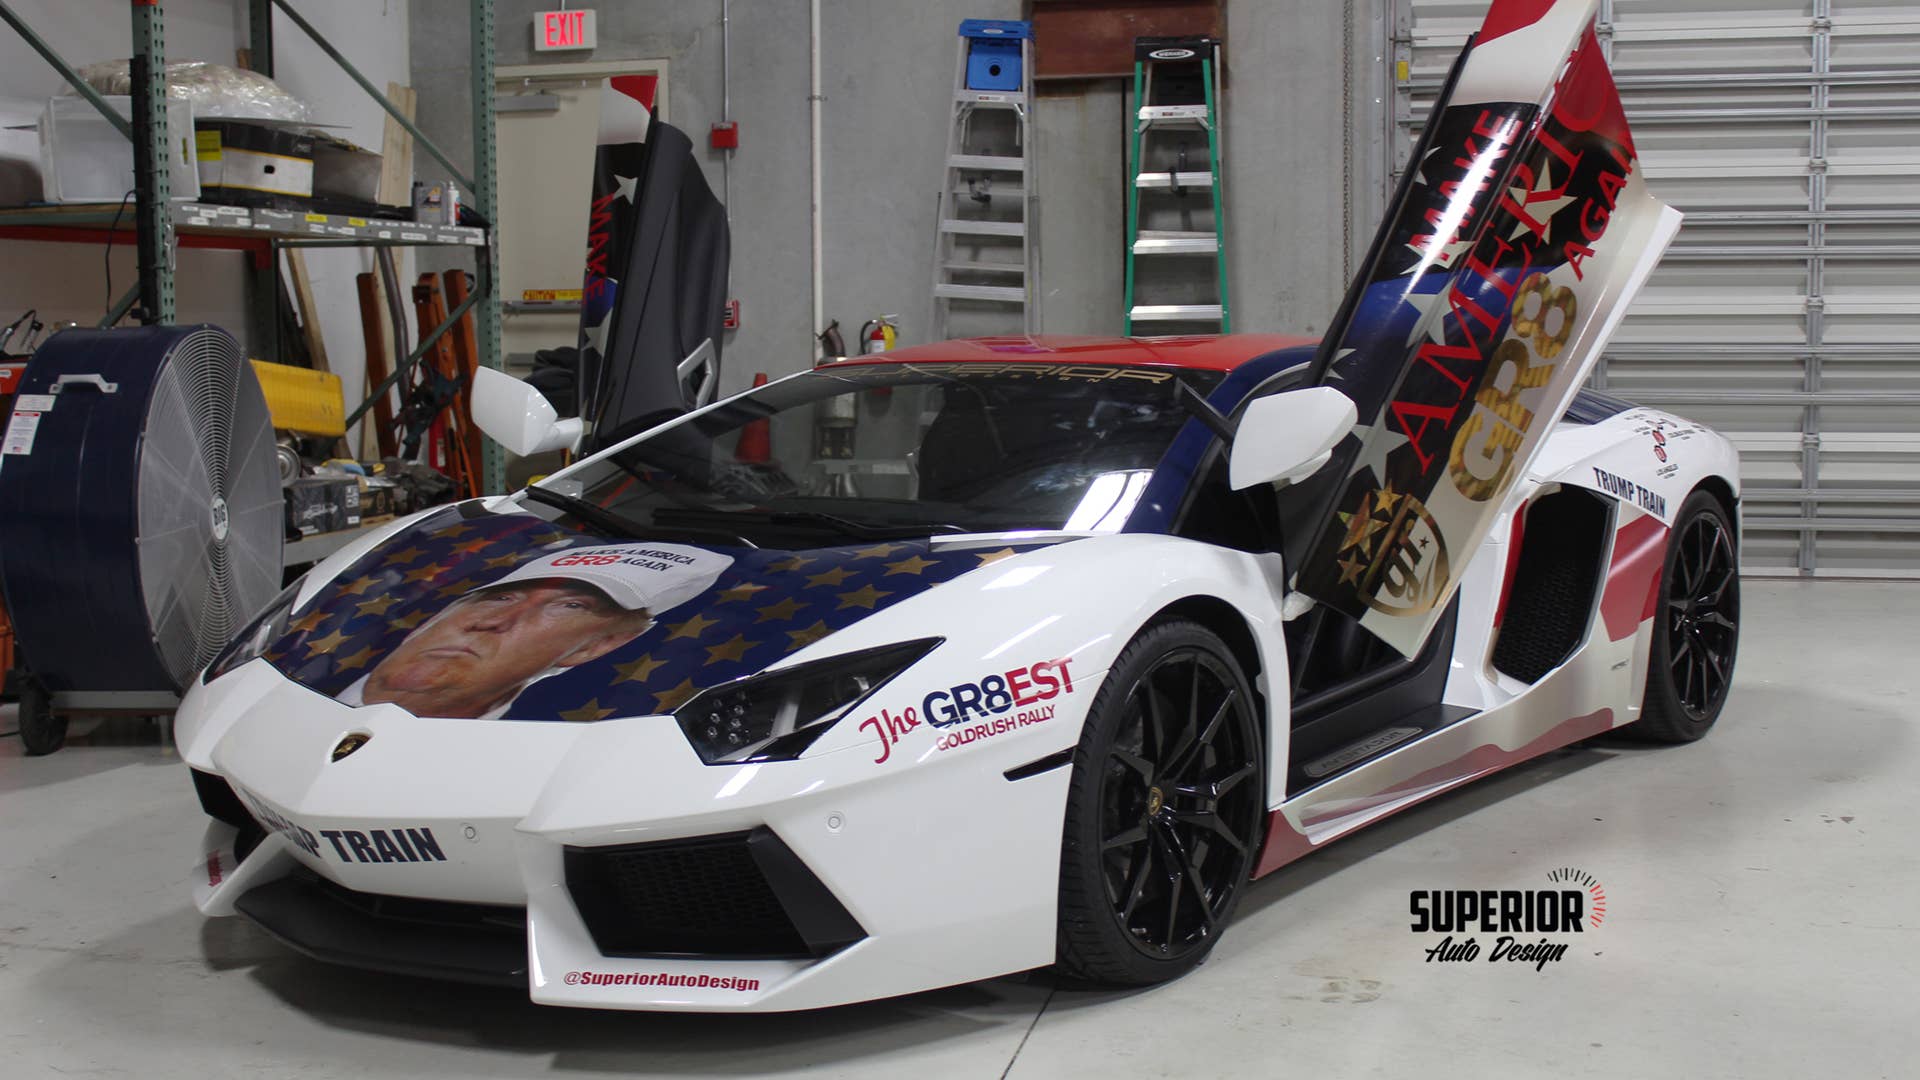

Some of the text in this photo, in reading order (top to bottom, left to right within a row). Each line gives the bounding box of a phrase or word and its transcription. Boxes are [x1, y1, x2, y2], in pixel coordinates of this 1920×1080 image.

[544, 11, 585, 47] EXIT
[1409, 110, 1524, 262] MAKE
[584, 192, 615, 304] MAKE
[1450, 272, 1577, 502] GR8
[1593, 466, 1635, 501] TRUMP
[1636, 484, 1666, 518] TRAIN
[551, 555, 673, 572] GR8 AGAIN
[626, 549, 696, 565] AMERICA
[859, 657, 1074, 764] The GR8EST
[936, 704, 1056, 751] GOLDRUSH RALLY
[319, 827, 448, 863] TRAIN
[564, 971, 760, 991] @SuperiorAutoDesign
